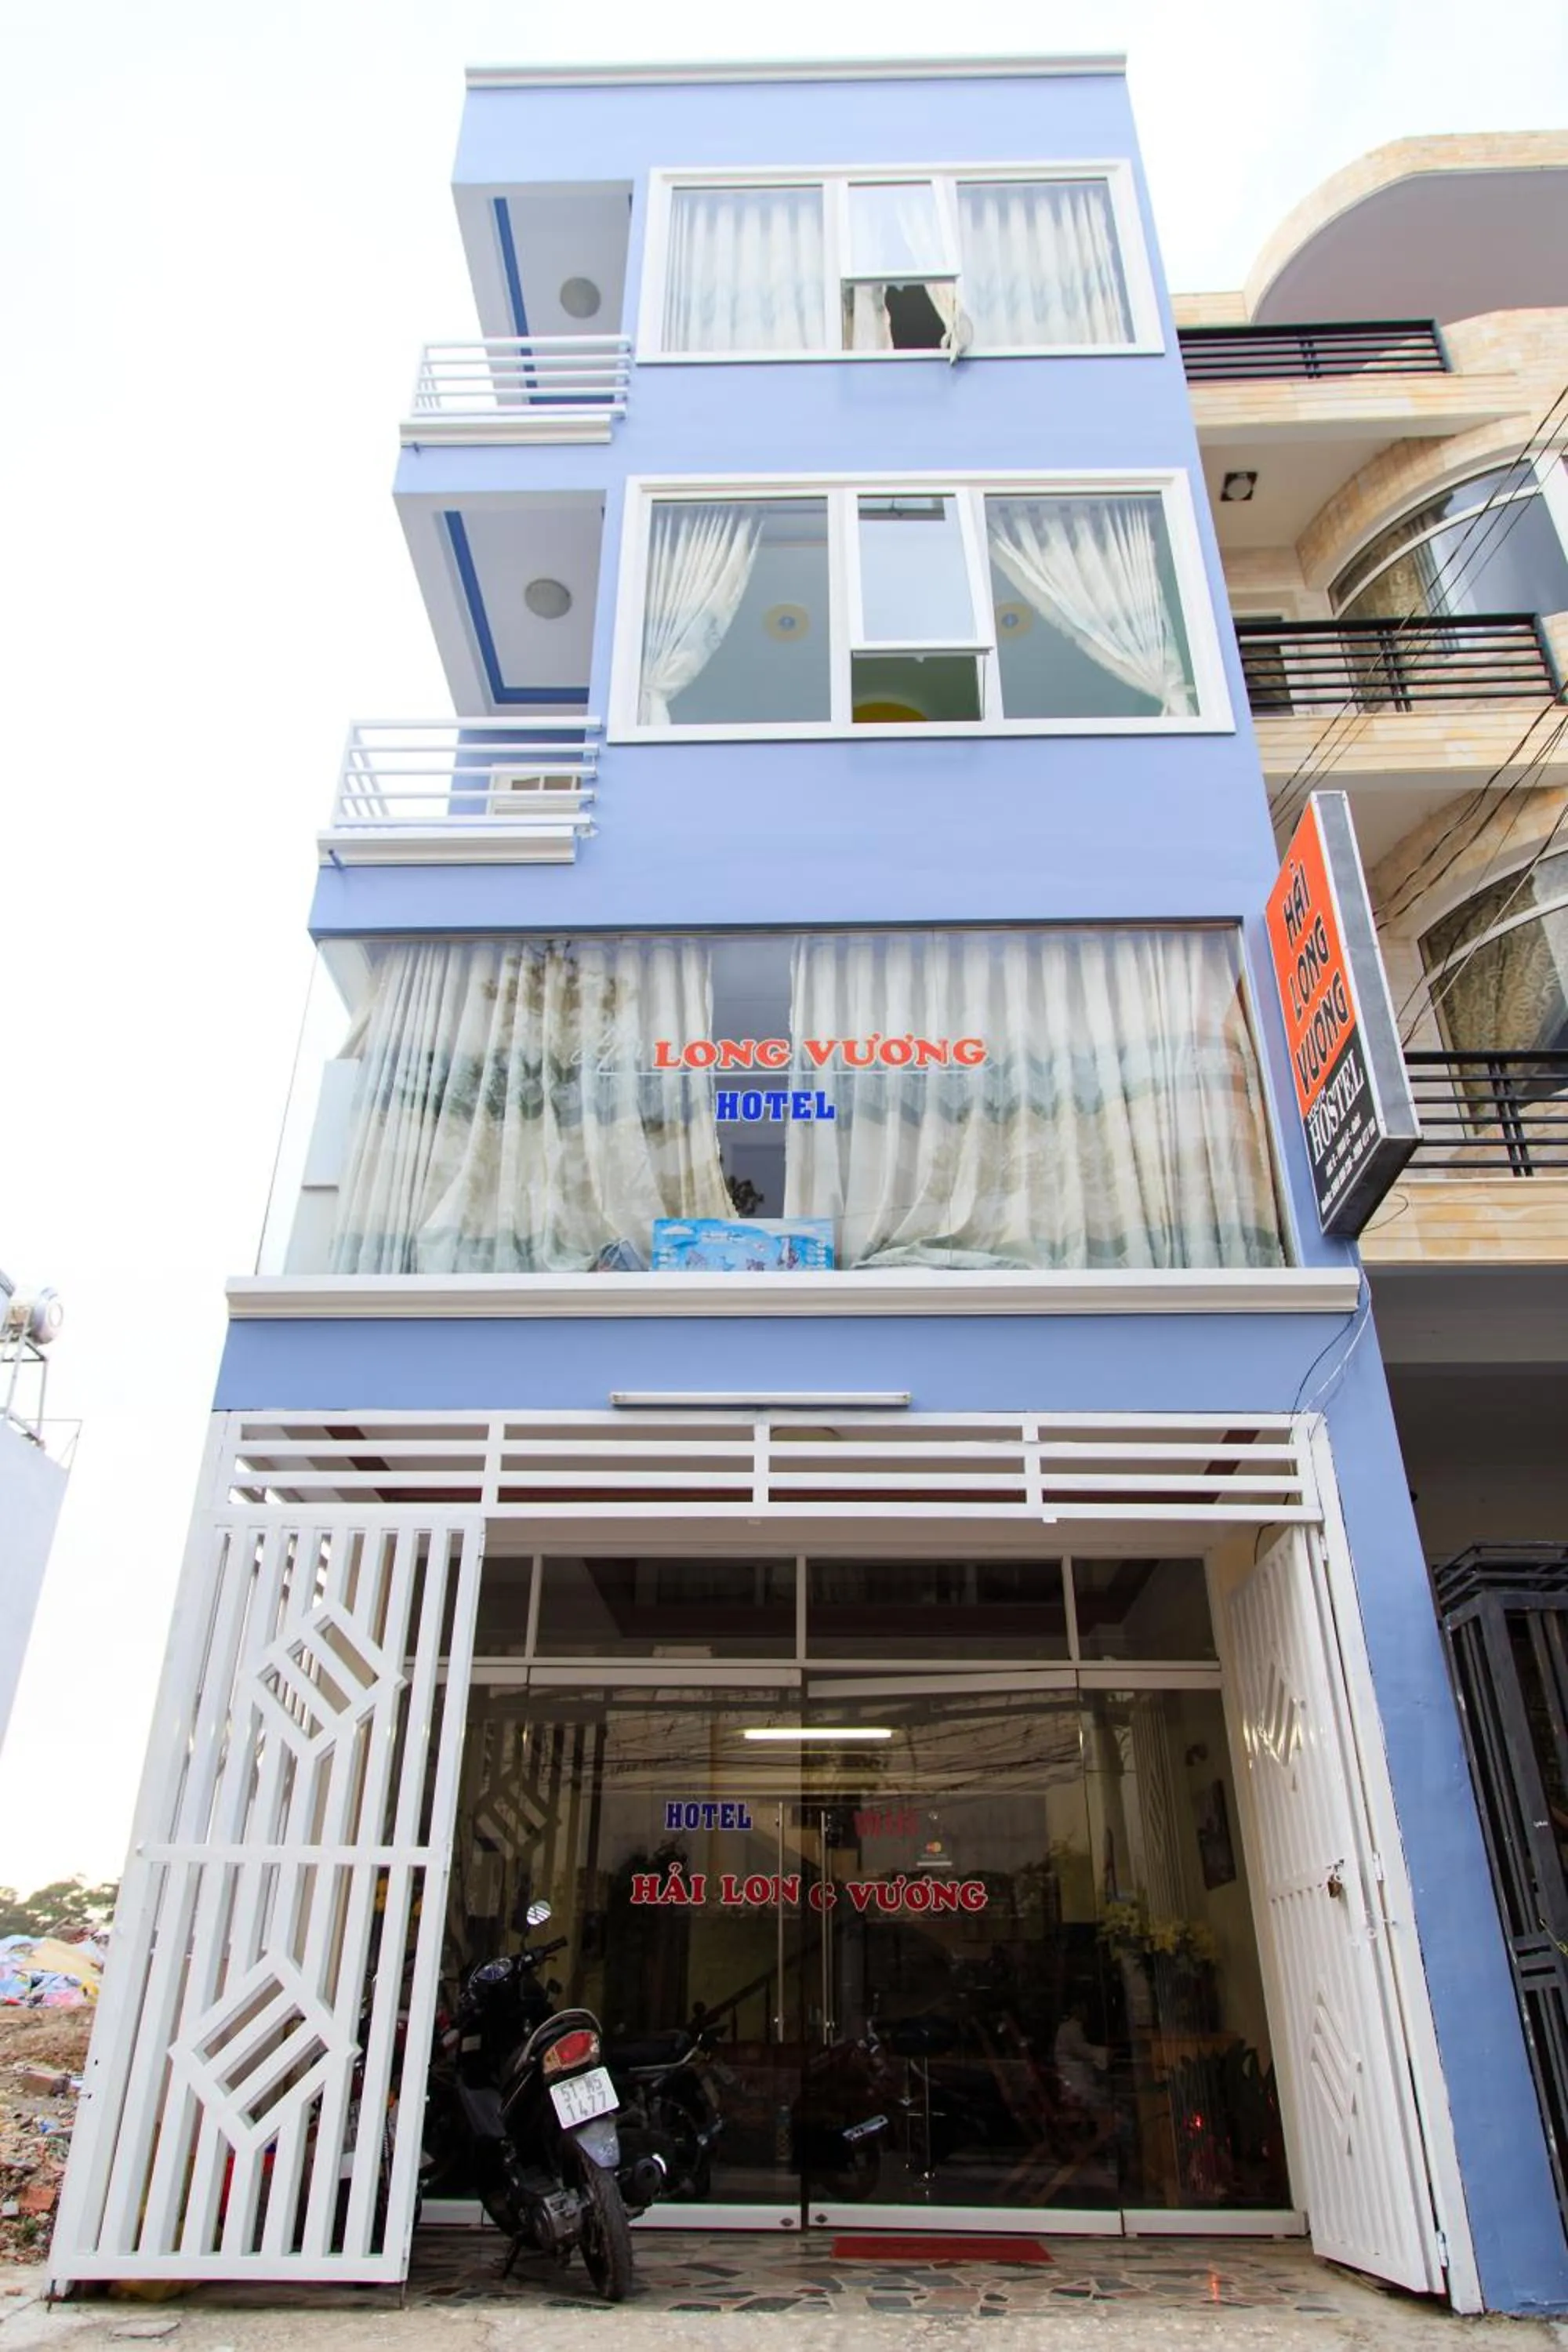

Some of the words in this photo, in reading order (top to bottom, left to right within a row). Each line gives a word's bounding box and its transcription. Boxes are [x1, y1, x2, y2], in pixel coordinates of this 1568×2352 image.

[1288, 913, 1330, 1022] LONG
[655, 1040, 790, 1068] LONG
[804, 1033, 986, 1067] VƯƠNG
[717, 1091, 835, 1120] HOTEL
[1308, 1048, 1365, 1165] HOSTEL
[666, 1803, 752, 1830] HOTEL
[631, 1862, 706, 1904] HẢI
[848, 1877, 988, 1911] VƯƠNG
